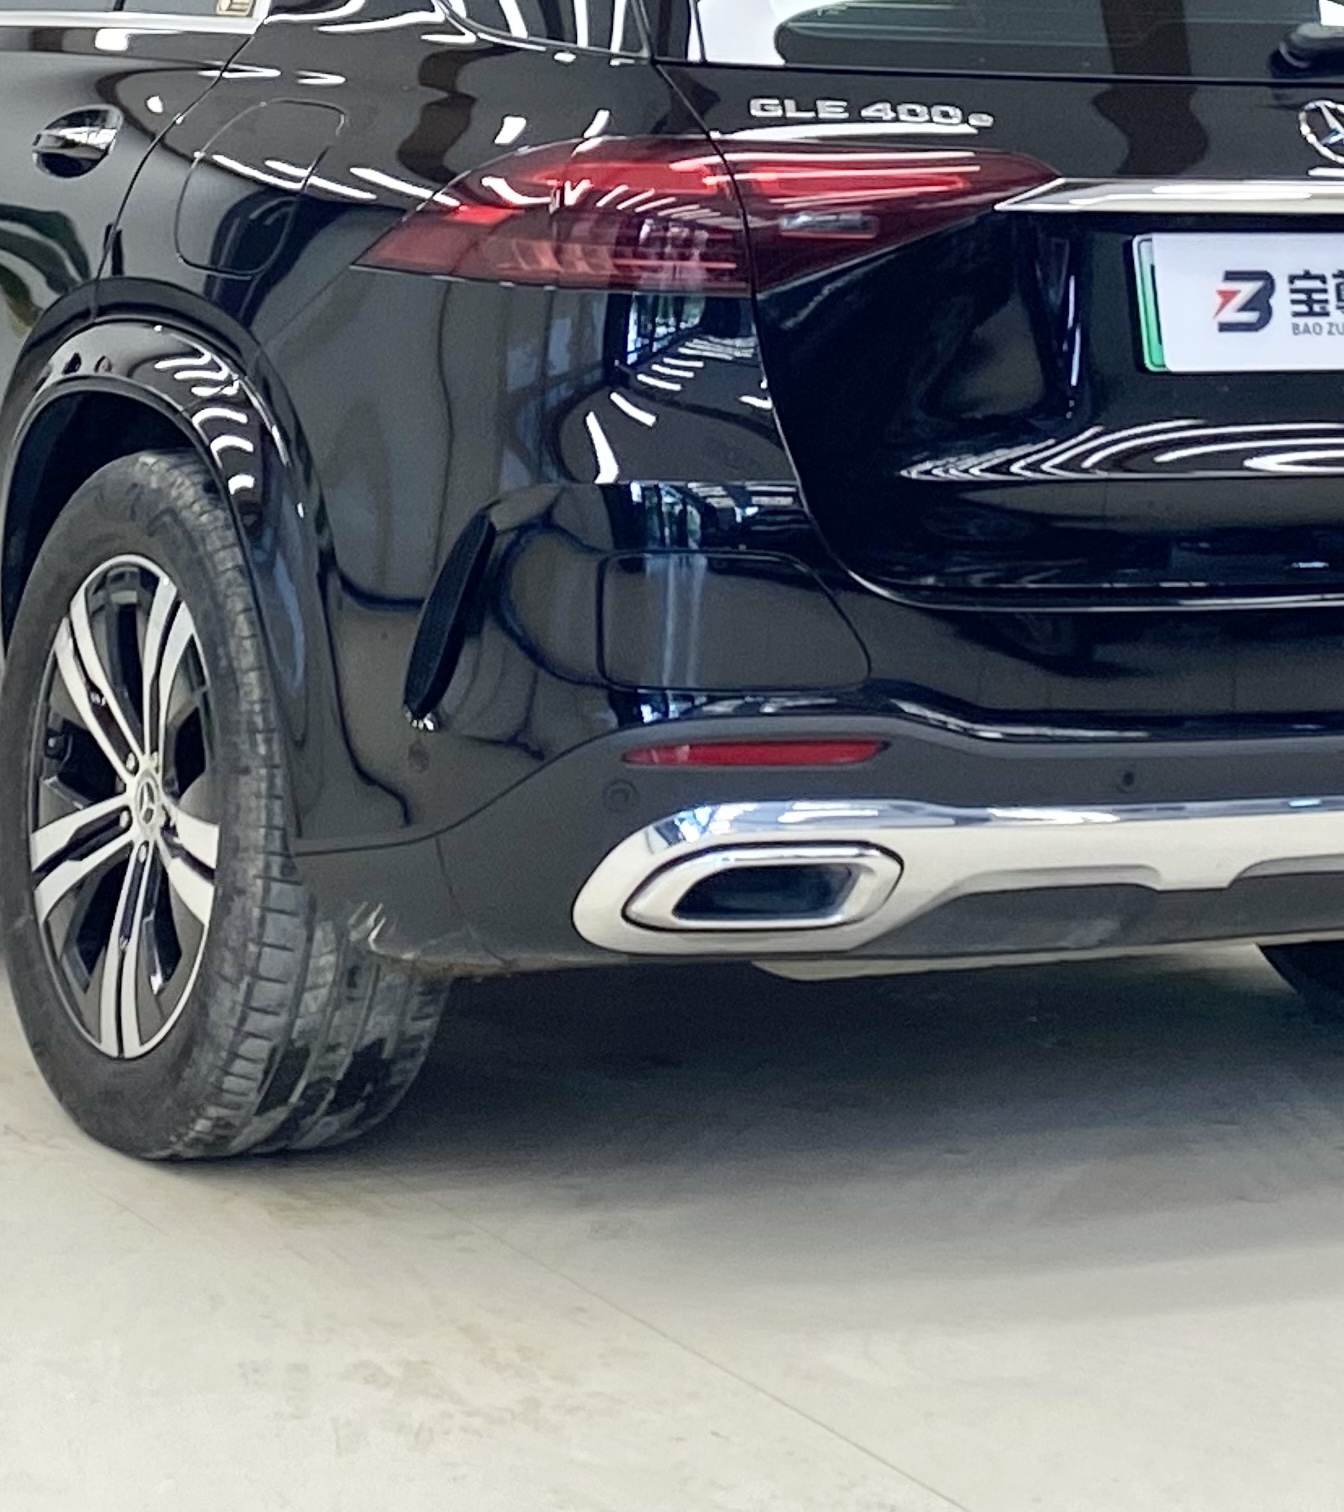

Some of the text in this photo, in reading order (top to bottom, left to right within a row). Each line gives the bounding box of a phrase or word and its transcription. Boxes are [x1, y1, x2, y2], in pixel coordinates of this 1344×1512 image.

[749, 97, 995, 128] GLE 400e
[1291, 321, 1324, 336] BAO
